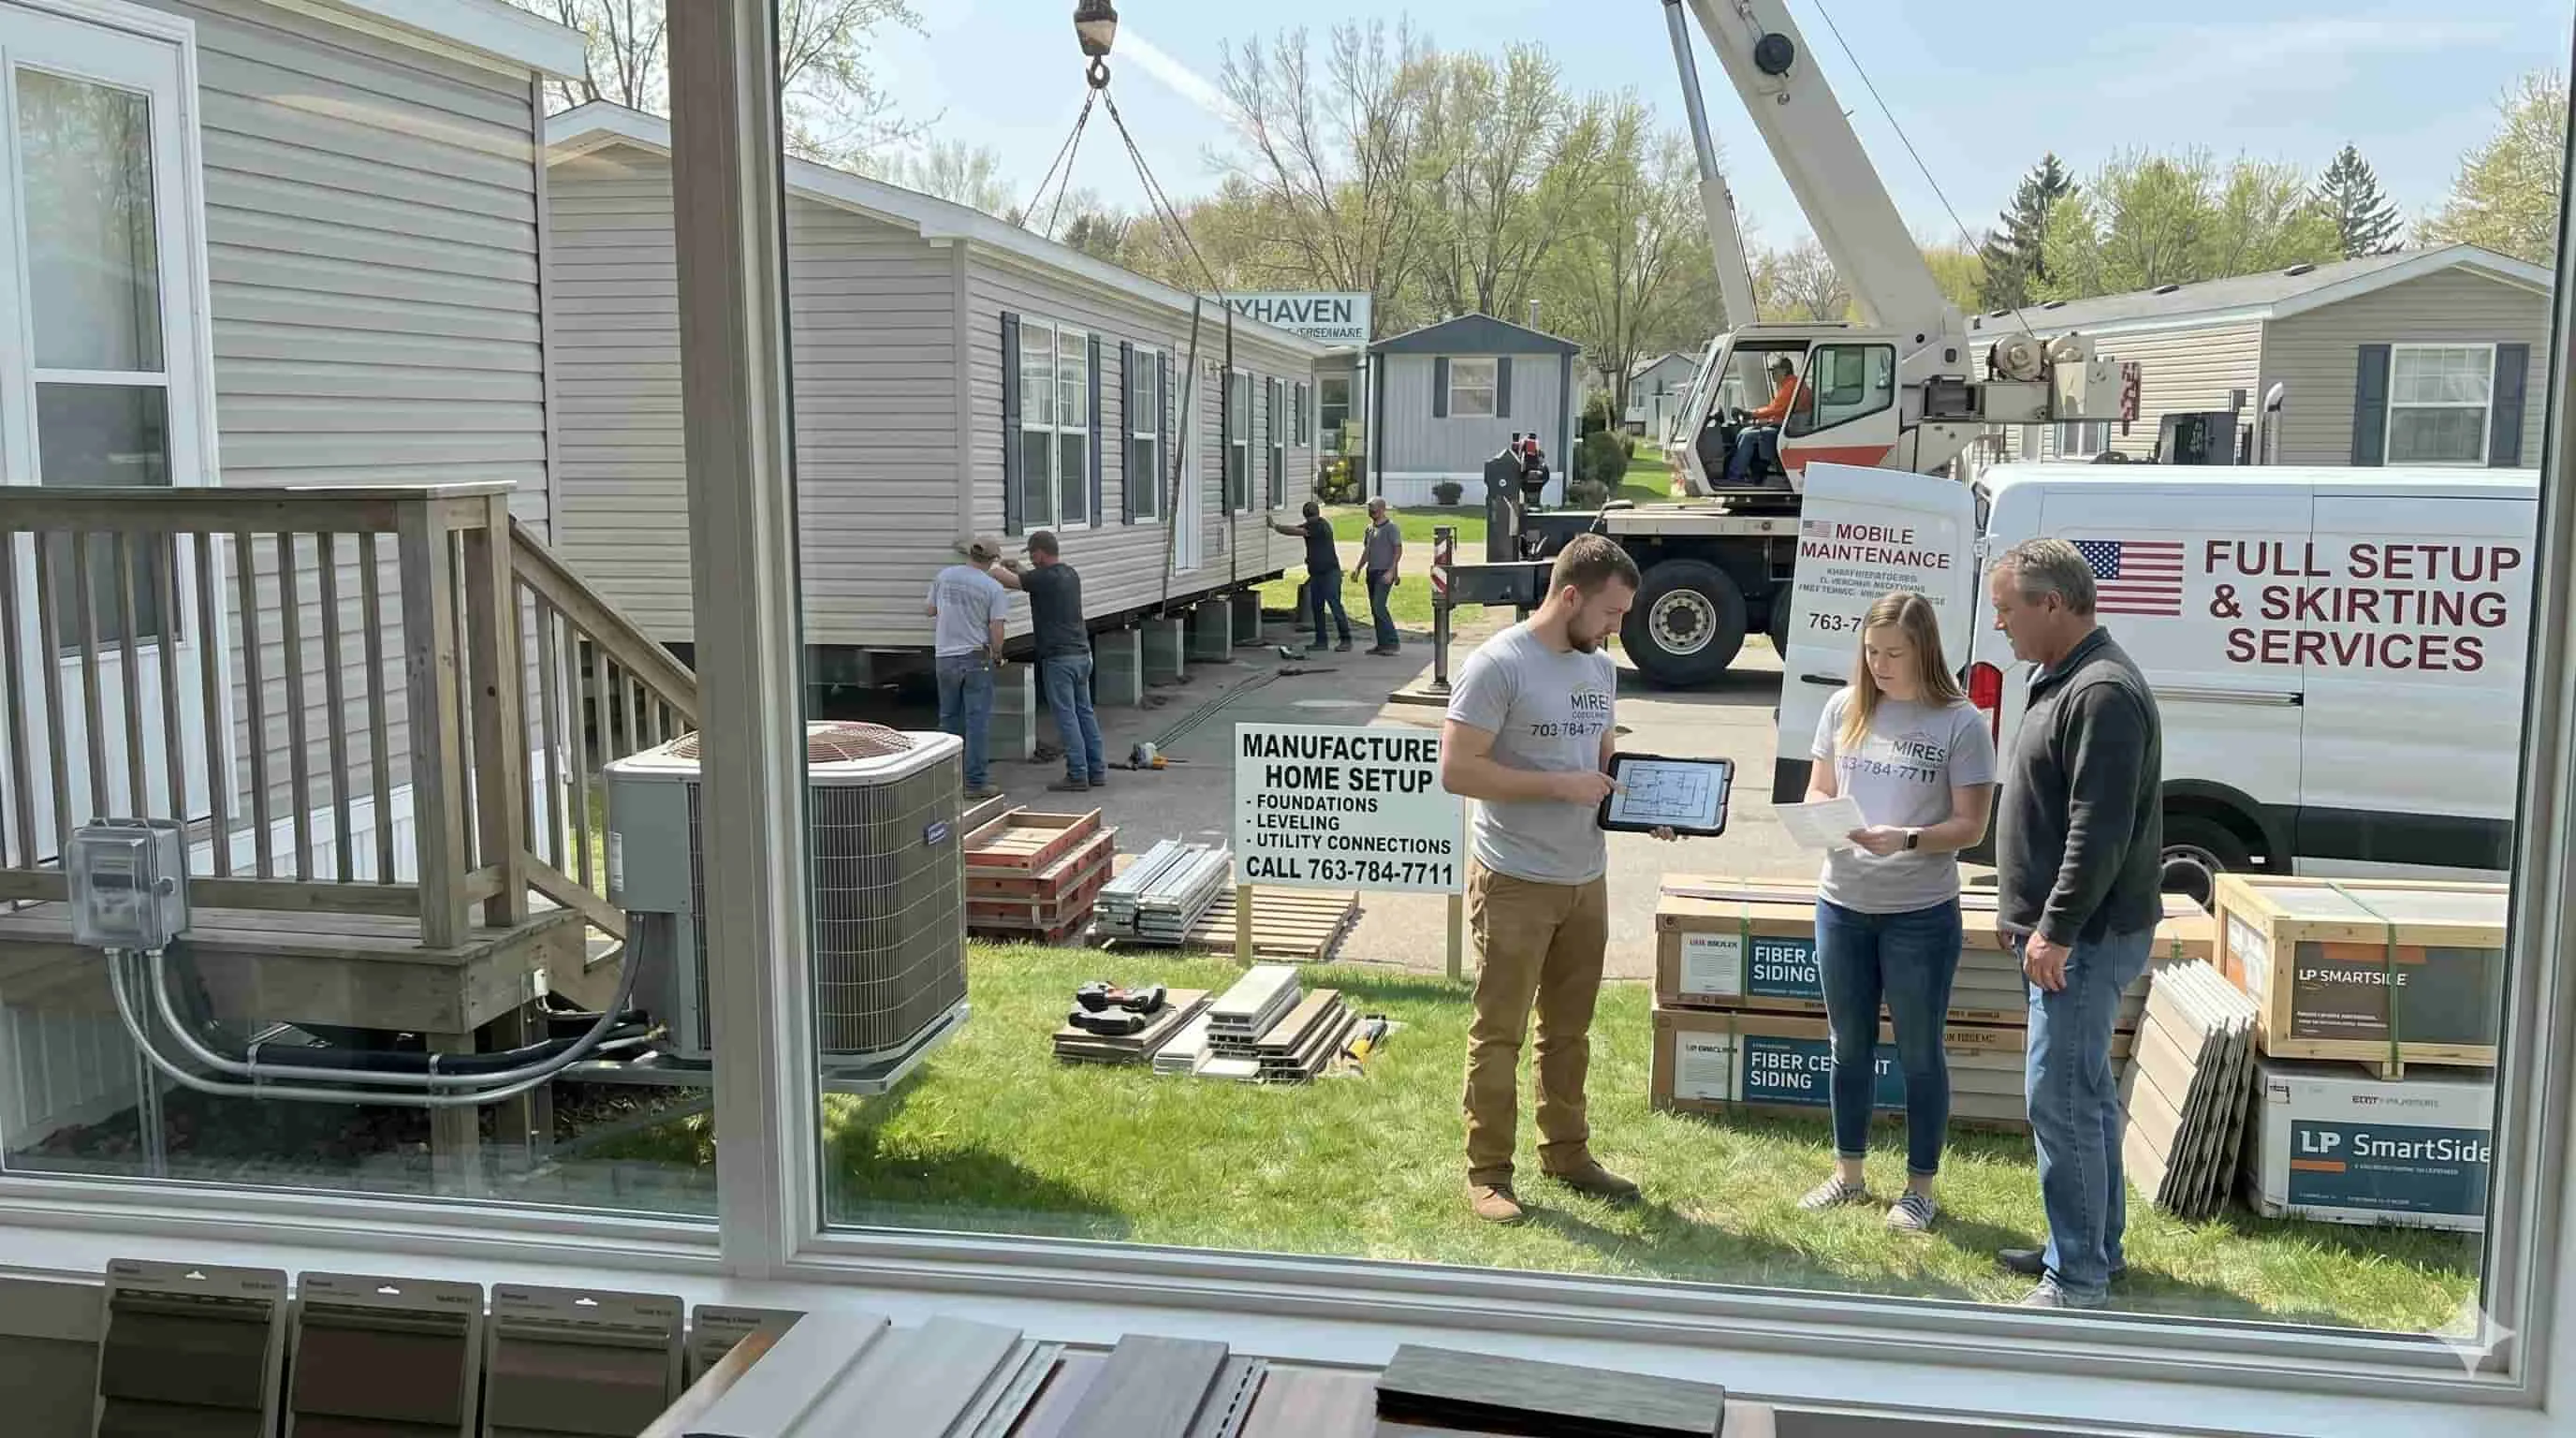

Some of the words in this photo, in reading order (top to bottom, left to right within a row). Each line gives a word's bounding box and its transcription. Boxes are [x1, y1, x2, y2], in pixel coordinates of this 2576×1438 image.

[1229, 299, 1352, 323] YHAVEN
[1836, 523, 1914, 545] MOBILE
[1801, 541, 1951, 569] MAINTENANCE
[2203, 539, 2332, 578] FULL
[2348, 543, 2522, 582] SETUP
[2209, 583, 2243, 620] &
[2260, 585, 2508, 627] SKIRTING
[2225, 628, 2484, 672] SERVICES
[1571, 694, 1609, 711] MIRE
[1243, 733, 1442, 763] MANUFACTURE
[1894, 741, 1946, 763] MIRES
[1266, 765, 1339, 790] HOME
[1348, 767, 1433, 794] SETUP
[1257, 794, 1378, 813] FOUNDATIONS
[1257, 814, 1340, 831] LEVELING
[1257, 833, 1323, 849] UTILITY
[1327, 836, 1451, 855] CONNECTIONS
[1246, 856, 1302, 878] CALL
[1308, 858, 1453, 885] 763-784-7711
[1755, 946, 1807, 964] FIBER
[1753, 964, 1816, 983] SIDING
[2298, 969, 2317, 981] LP
[1751, 1051, 1803, 1070] FIBER
[1750, 1071, 1812, 1090] SIDING
[2299, 1130, 2341, 1153] LP
[2353, 1134, 2492, 1163] SmartSide
